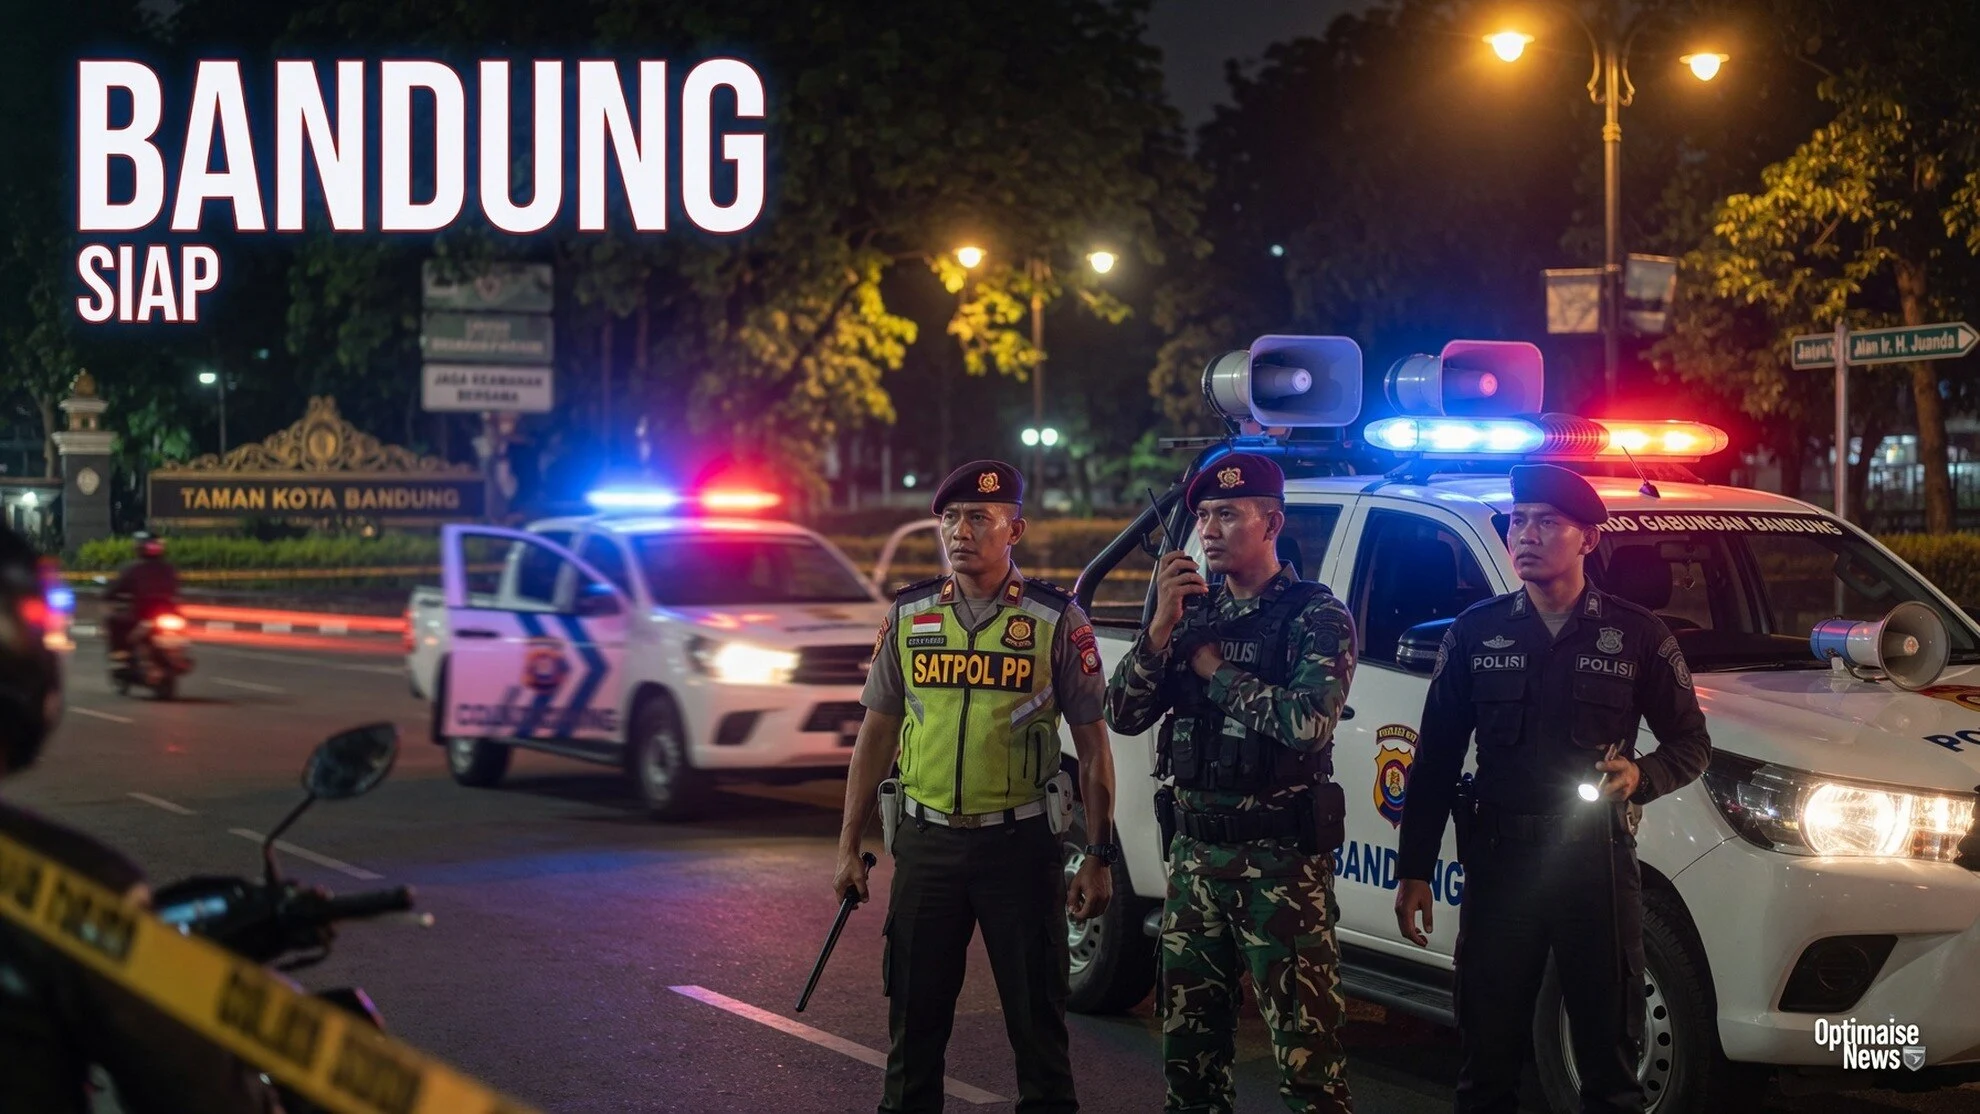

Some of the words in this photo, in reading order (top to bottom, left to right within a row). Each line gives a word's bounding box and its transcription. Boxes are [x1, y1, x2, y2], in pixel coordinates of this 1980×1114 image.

[1911, 331, 1955, 353] Juanda
[435, 373, 467, 386] JAGA
[181, 487, 265, 509] TAMAN
[272, 487, 337, 509] KOTA
[344, 487, 459, 510] BANDUNG
[1638, 515, 1751, 532] GABUNGAN
[1750, 516, 1843, 536] BANDUNG
[1220, 639, 1258, 664] OLISI
[1473, 655, 1525, 670] POLISI
[913, 653, 995, 685] SATPOL
[1001, 656, 1031, 688] PP
[1579, 657, 1634, 677] POLISI
[1333, 840, 1465, 906] BANDNG
